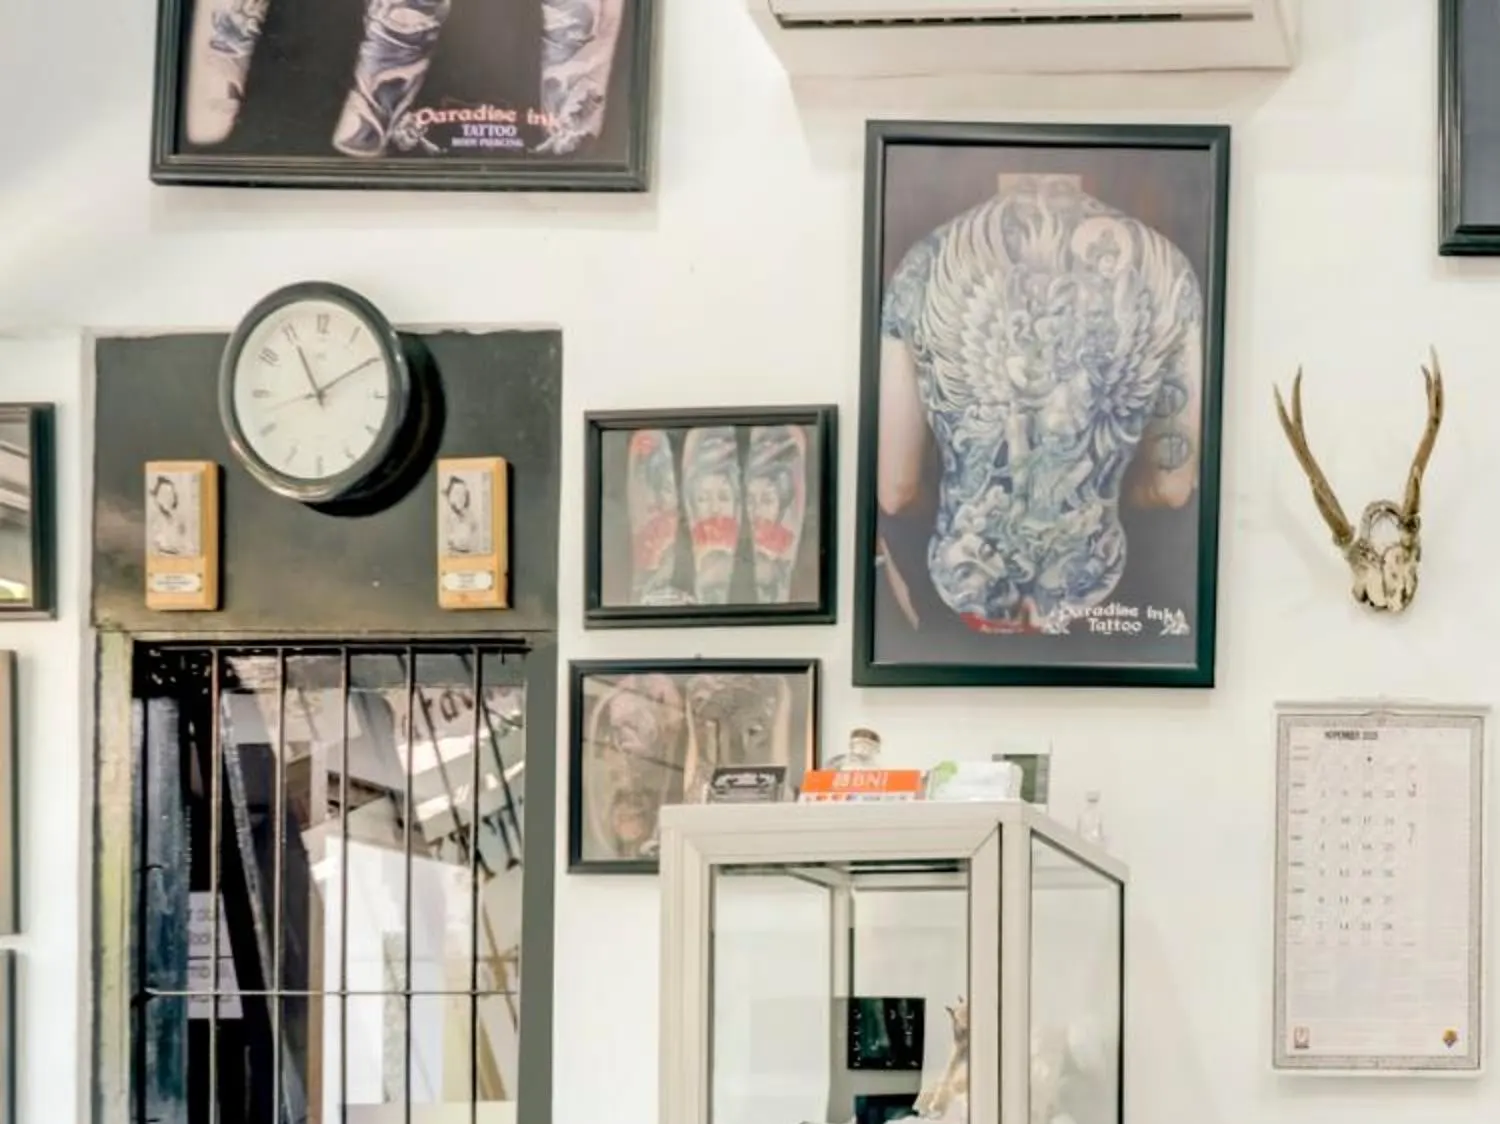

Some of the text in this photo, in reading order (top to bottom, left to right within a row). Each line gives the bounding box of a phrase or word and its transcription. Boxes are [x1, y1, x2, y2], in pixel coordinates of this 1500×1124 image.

[415, 104, 517, 128] Paradise
[461, 124, 518, 137] TATTOO
[316, 313, 330, 334] 12
[1059, 602, 1140, 621] Paradise
[1088, 617, 1143, 634] Tattoo
[853, 771, 889, 787] BNI
